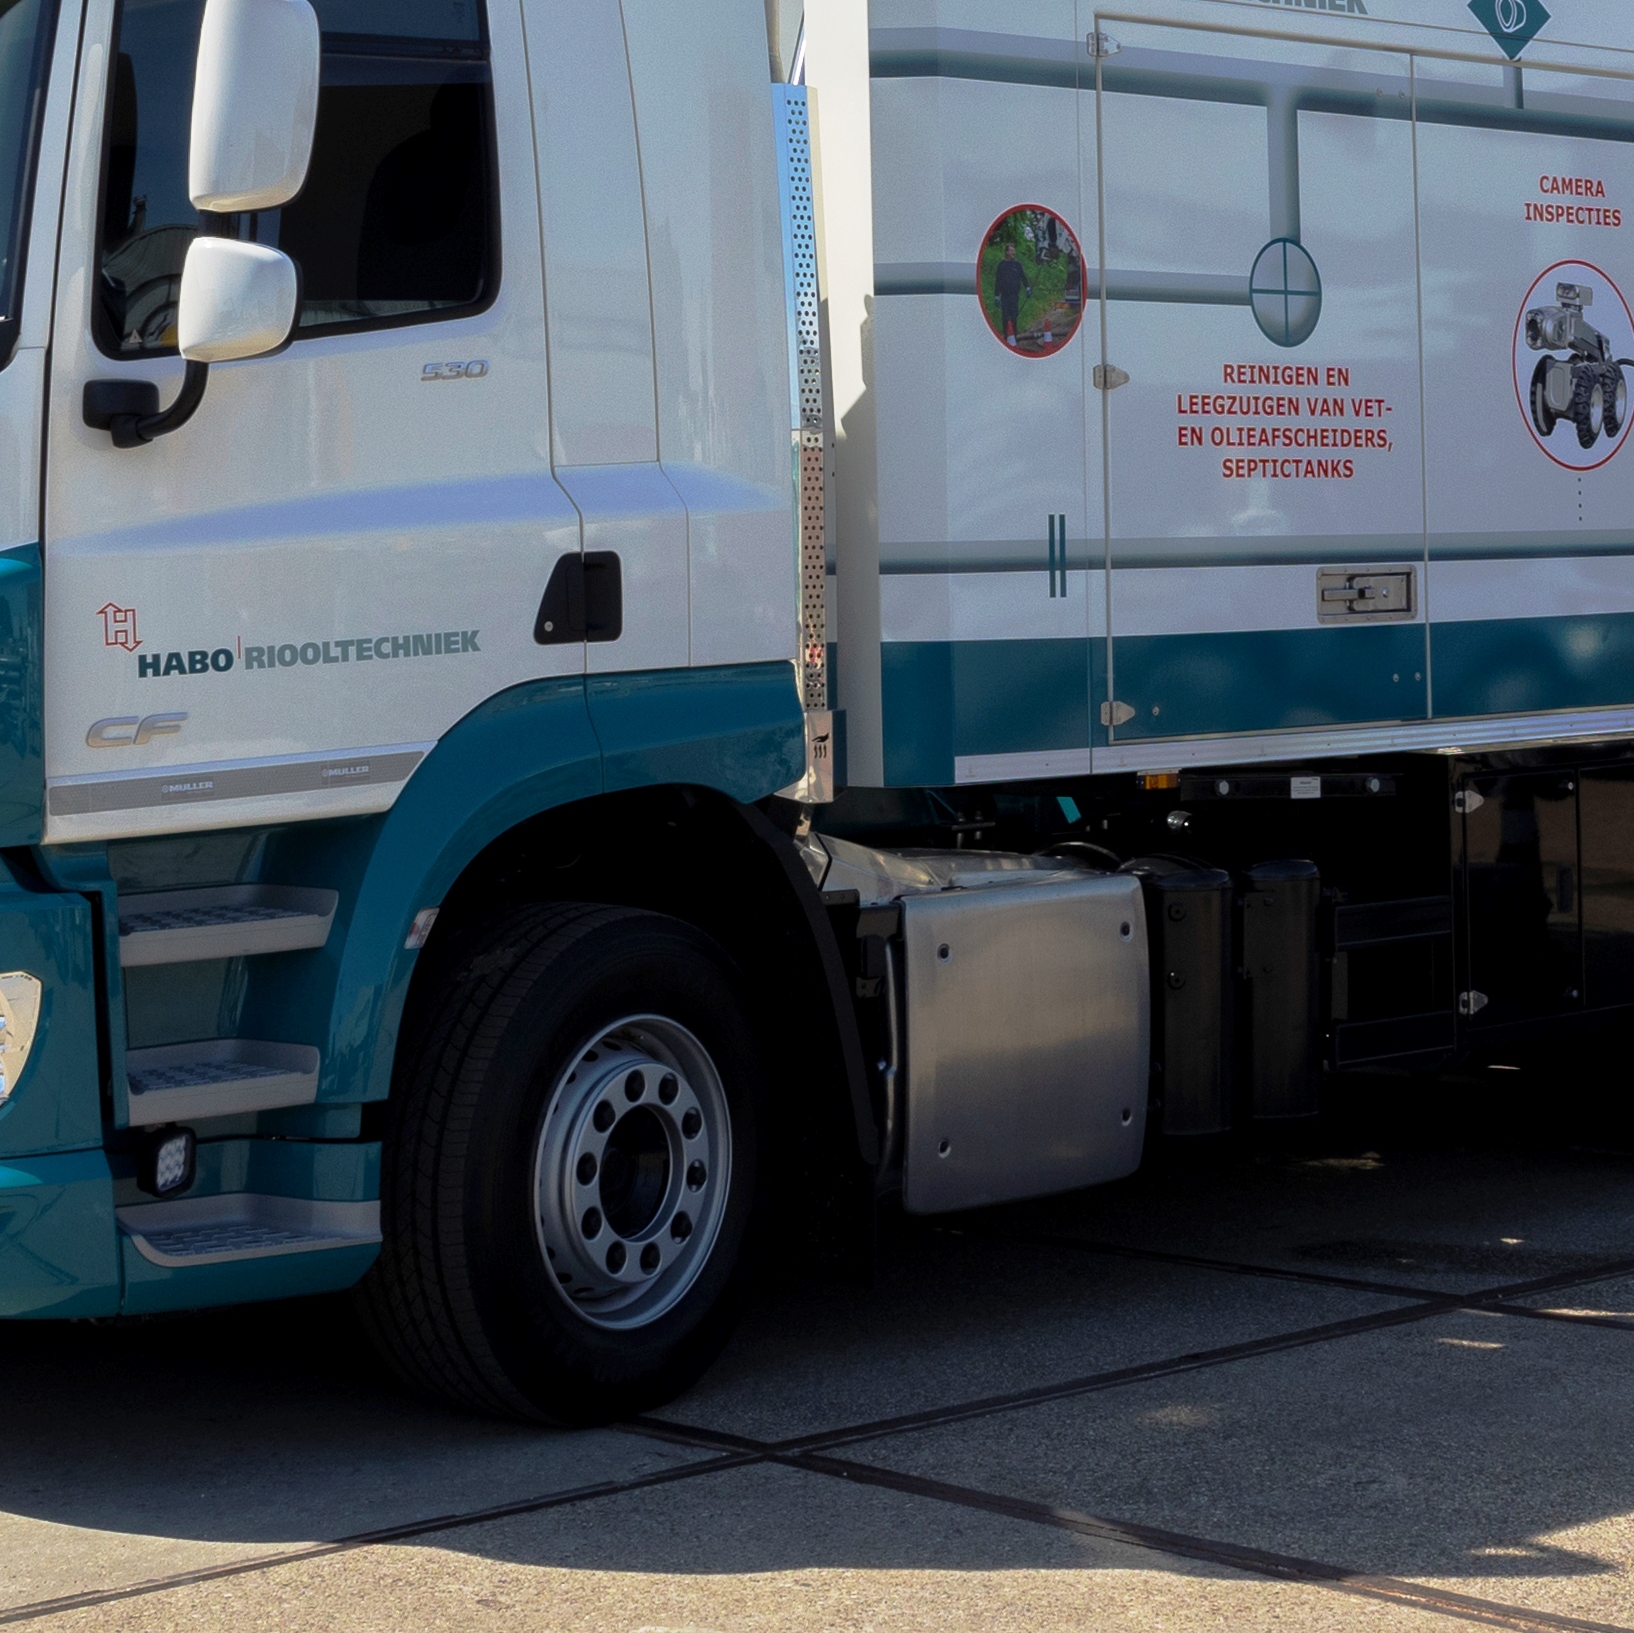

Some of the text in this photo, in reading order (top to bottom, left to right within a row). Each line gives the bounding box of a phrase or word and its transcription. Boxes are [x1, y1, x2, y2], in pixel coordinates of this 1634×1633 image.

[1539, 175, 1606, 198] CAMERA
[1524, 202, 1622, 227] INSPECTIES
[420, 359, 489, 382] 530
[1223, 364, 1350, 386] REINIGEN EN
[1176, 394, 1393, 417] LEEGZUIGEN VAN VET-
[1177, 426, 1393, 452] EN OLIEAFSCHEIDERS,
[1222, 458, 1354, 478] SEPTICTANKS
[138, 630, 481, 678] HABO RIOOLTECHNIEK
[85, 711, 188, 748] CF
